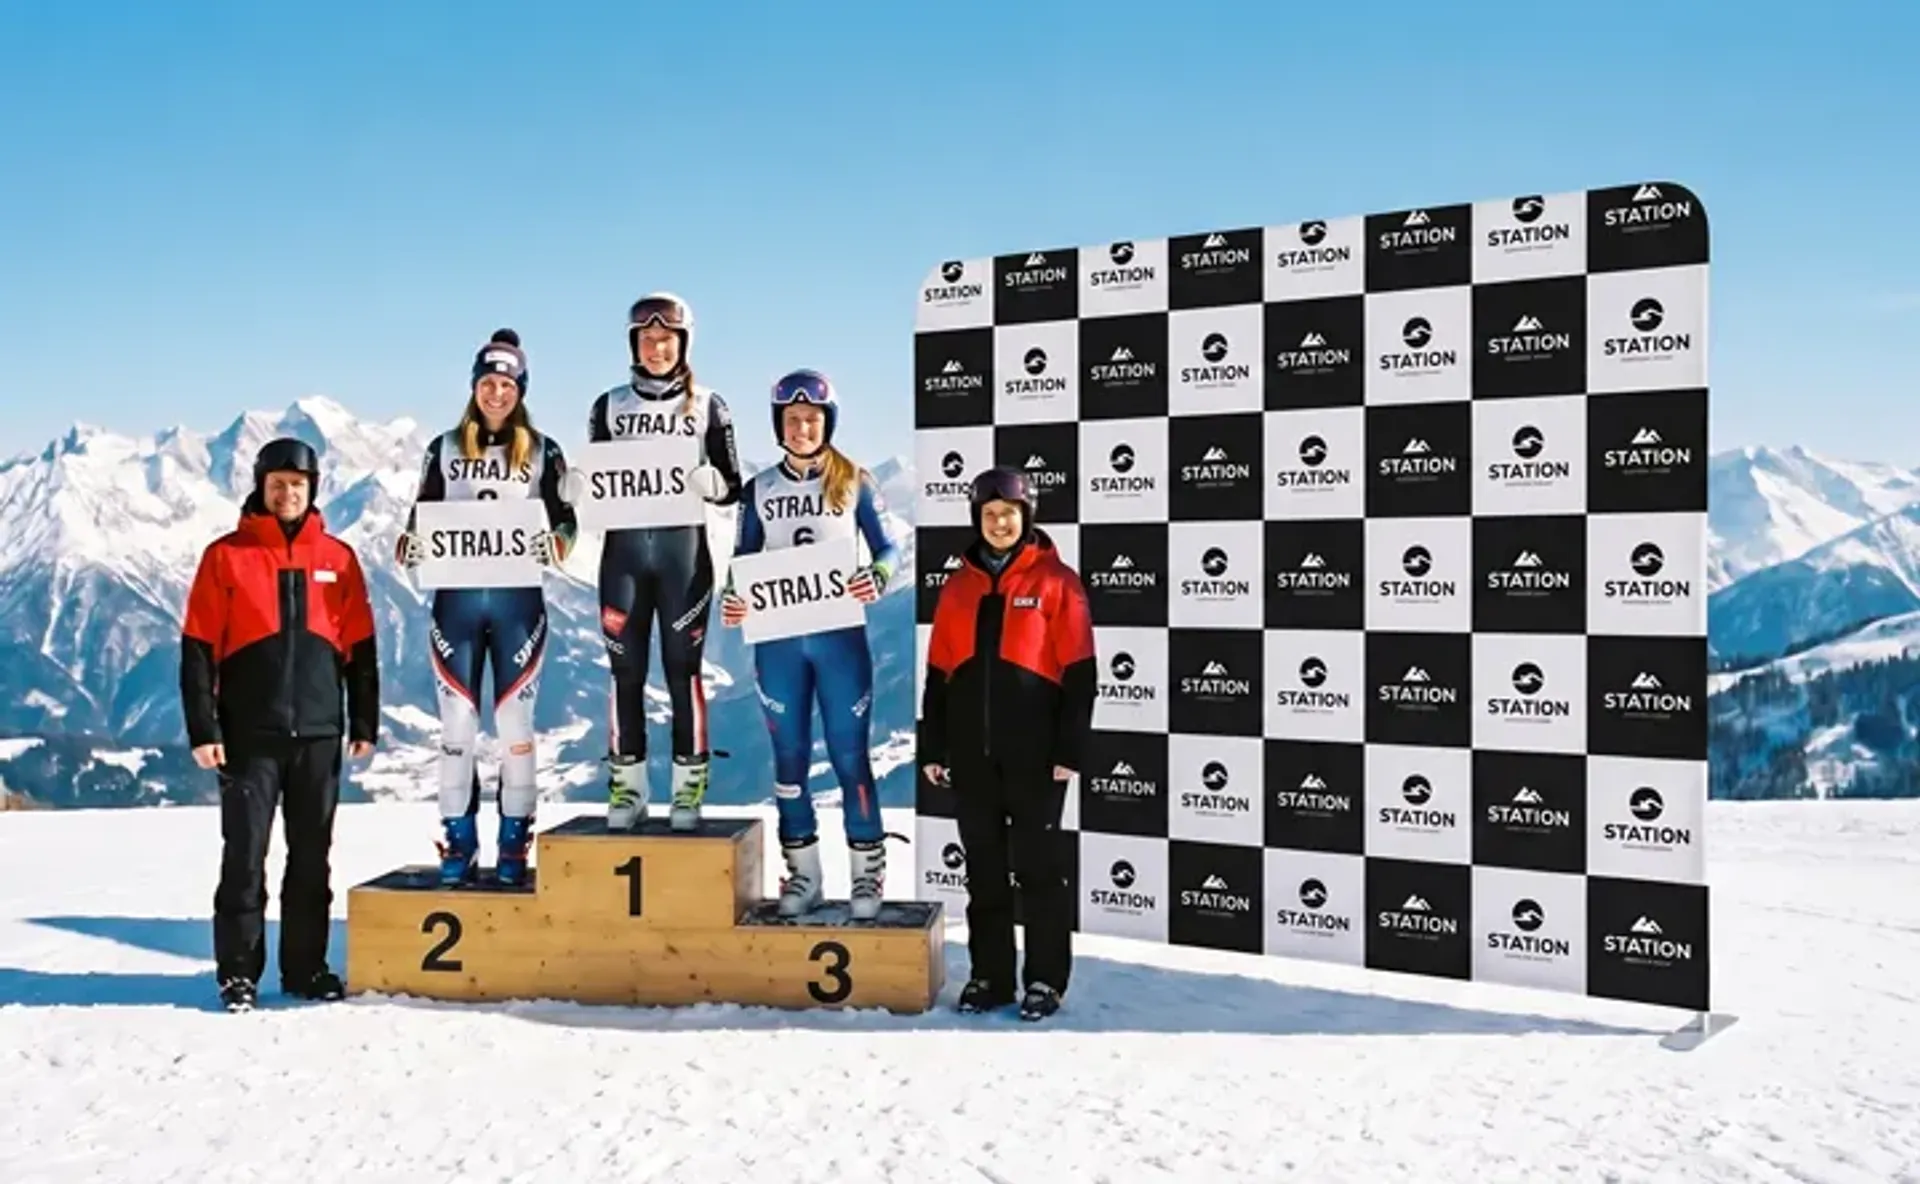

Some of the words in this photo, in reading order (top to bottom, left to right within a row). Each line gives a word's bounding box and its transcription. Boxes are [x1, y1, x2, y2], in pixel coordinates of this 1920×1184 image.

[1603, 202, 1692, 225] STATION
[1378, 226, 1457, 248] STATION
[1487, 224, 1570, 246] STATION
[1180, 249, 1250, 268] STATION
[1276, 247, 1351, 267] STATION
[1004, 267, 1068, 286] STATION
[1090, 266, 1156, 286] STATION
[924, 285, 983, 302] STATION
[1487, 333, 1570, 353] STATION
[1603, 334, 1692, 355] STATION
[1276, 349, 1351, 367] STATION
[1378, 351, 1457, 369] STATION
[1090, 362, 1156, 379] STATION
[1180, 364, 1250, 382] STATION
[924, 375, 983, 390] STATION
[1004, 377, 1068, 394] STATION
[614, 413, 697, 436] STRAJ.S
[1378, 457, 1457, 474] STATION
[1603, 448, 1692, 466] STATION
[448, 458, 533, 483] STRAJ.S
[1030, 471, 1068, 485] TION
[1180, 463, 1250, 480] STATION
[1276, 469, 1351, 486] STATION
[1487, 461, 1570, 479] STATION
[591, 467, 685, 499] STRAJ.S
[1090, 476, 1156, 491] STATION
[432, 529, 526, 557] STRAJ.S
[1090, 572, 1156, 587] STATION
[1180, 579, 1250, 595] STATION
[1276, 572, 1351, 587] STATION
[1378, 580, 1457, 596] STATION
[1487, 571, 1570, 588] STATION
[1603, 580, 1692, 597] STATION
[750, 569, 845, 611] STRAJ.S
[1180, 678, 1250, 694] STATION
[1378, 685, 1457, 702] STATION
[1276, 690, 1351, 707] STATION
[1487, 698, 1570, 716] STATION
[1603, 692, 1692, 710] STATION
[1090, 778, 1156, 795] STATION
[1180, 792, 1250, 811] STATION
[1276, 791, 1351, 810] STATION
[1378, 807, 1457, 827] STATION
[1487, 805, 1570, 825] STATION
[1603, 823, 1692, 844] STATION
[613, 856, 643, 916] 1
[1090, 889, 1156, 908] STATION
[1180, 890, 1250, 910] STATION
[1276, 909, 1351, 930] STATION
[1378, 911, 1457, 932] STATION
[420, 912, 463, 972] 2
[1487, 932, 1570, 954] STATION
[1603, 935, 1692, 961] STATION
[806, 941, 853, 1003] 3
